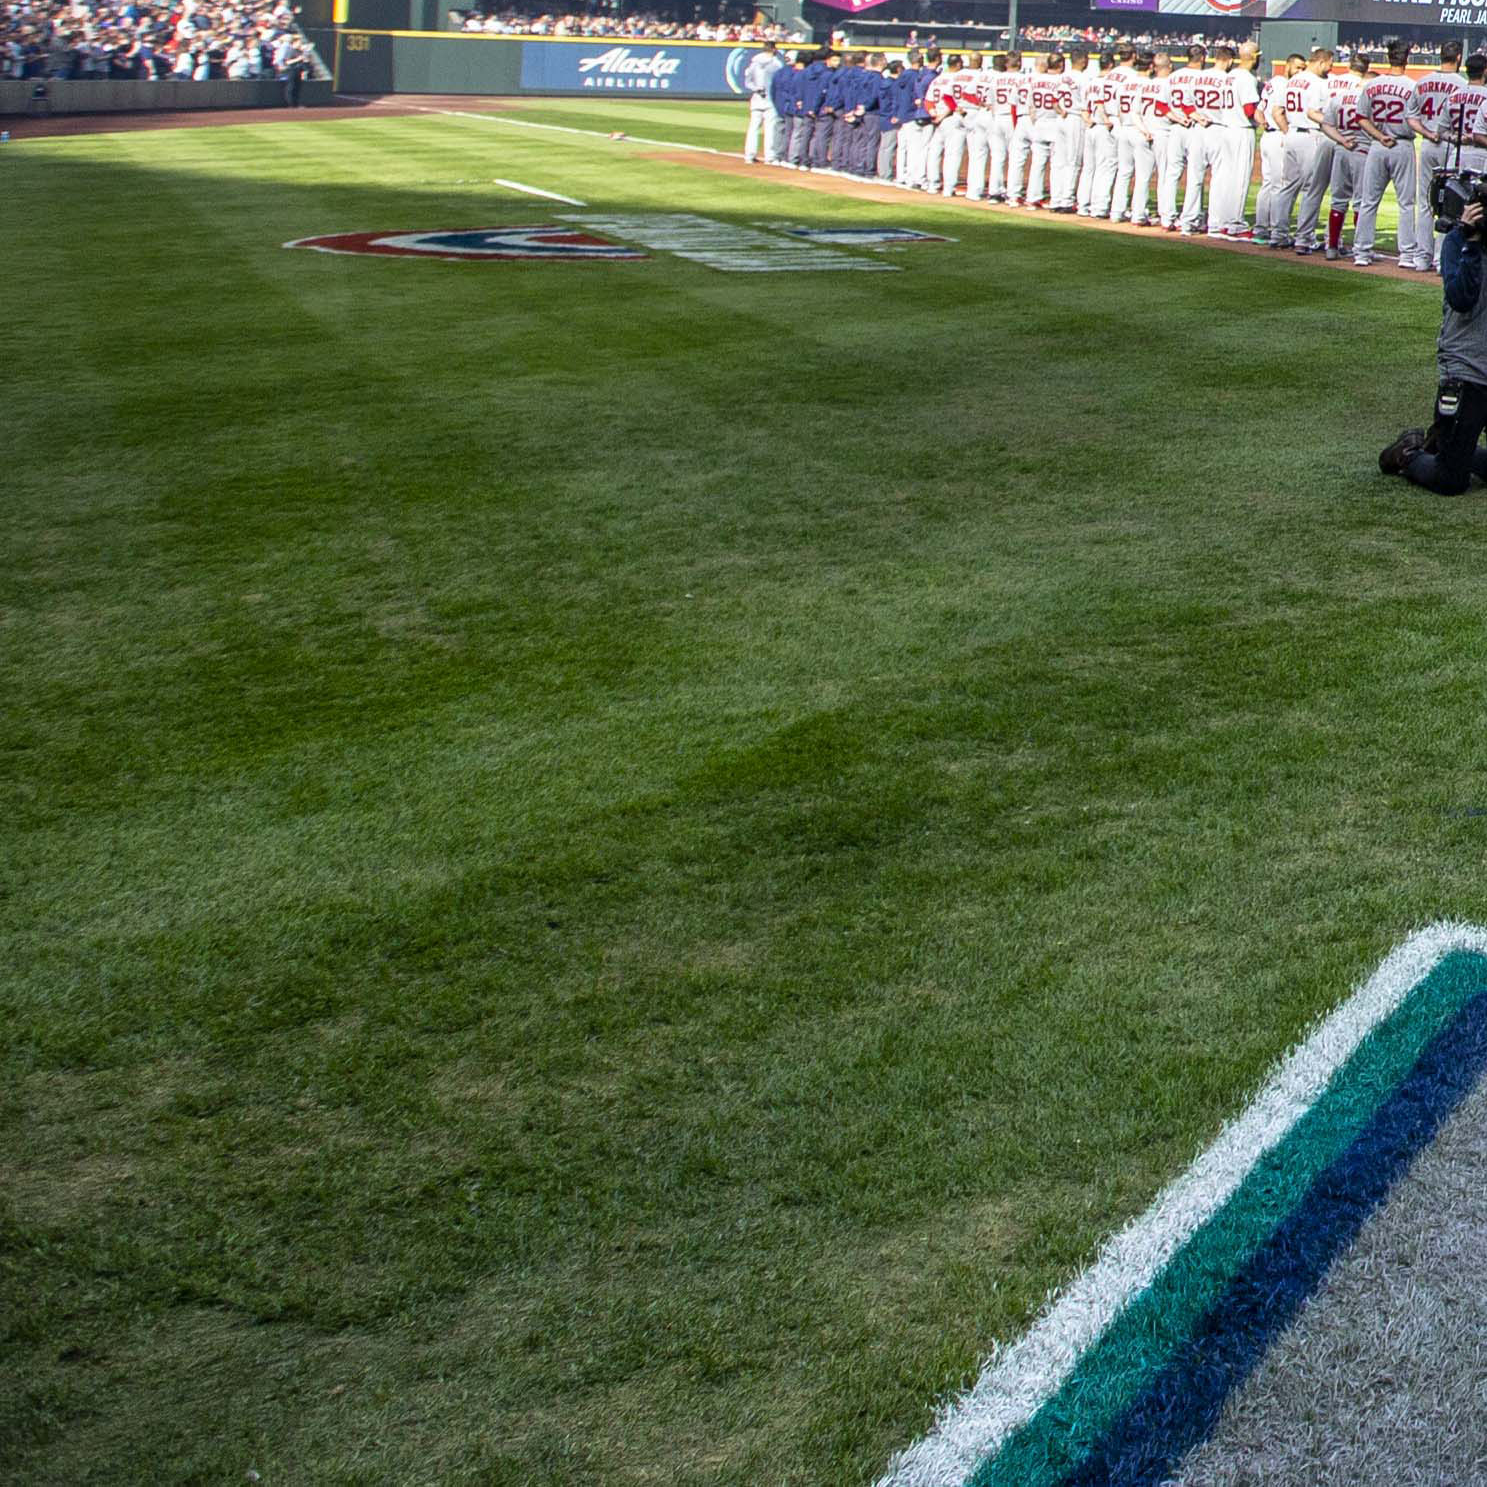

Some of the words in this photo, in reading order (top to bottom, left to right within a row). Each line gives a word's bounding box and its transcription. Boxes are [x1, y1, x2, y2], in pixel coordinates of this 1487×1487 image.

[1440, 8, 1472, 25] PEARL
[346, 34, 370, 51] 331
[578, 47, 681, 77] Alaska
[583, 76, 671, 88] AIRLINES
[1366, 82, 1413, 101] PORCELLO
[1194, 90, 1220, 109] 32
[1286, 91, 1304, 113] 61
[1338, 108, 1360, 130] 12
[1371, 99, 1405, 124] 22
